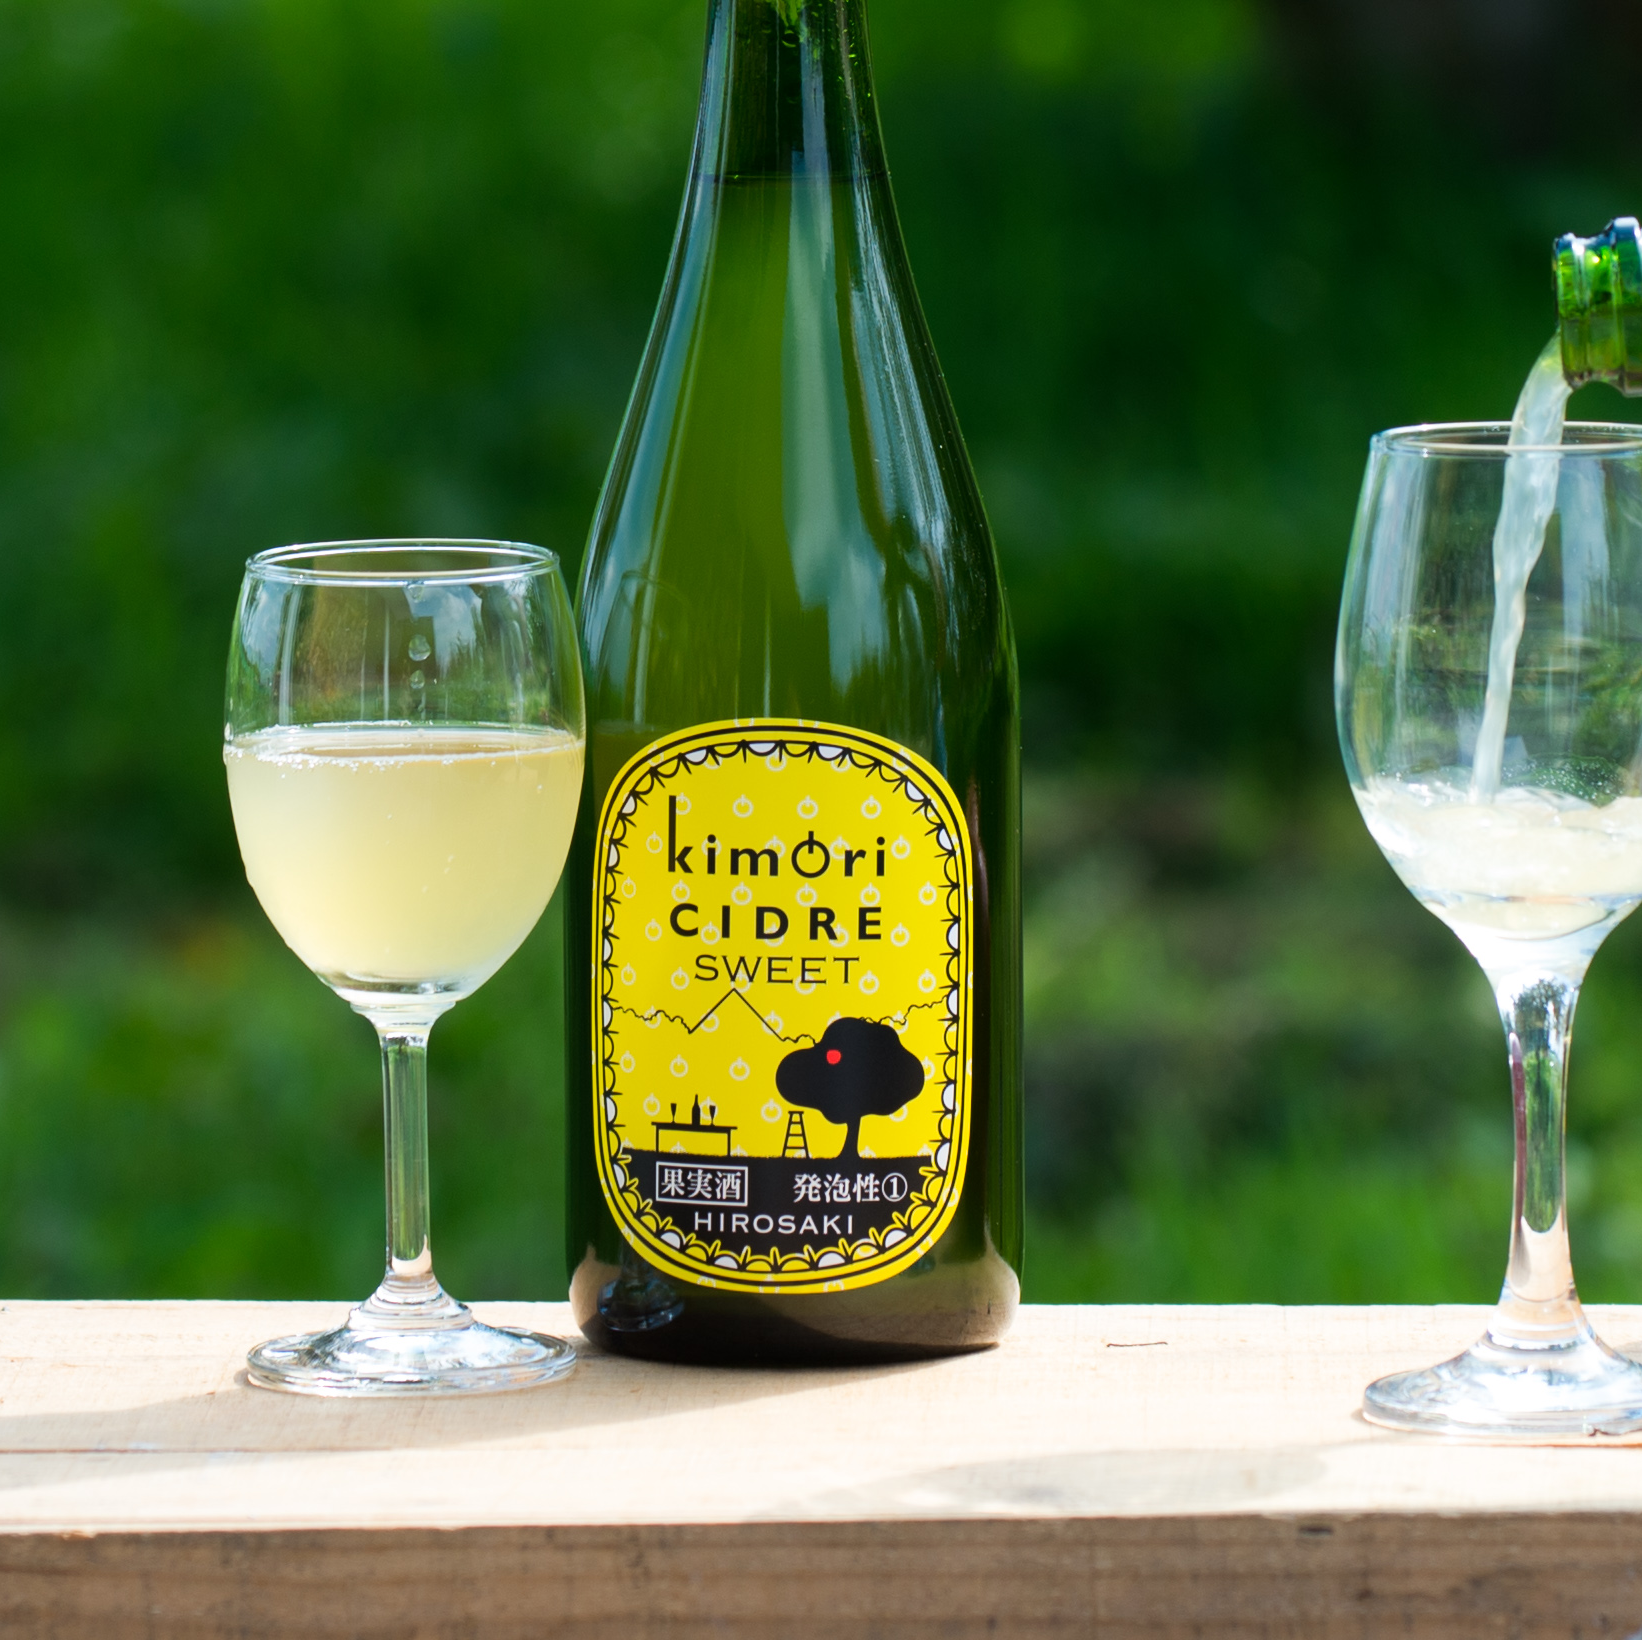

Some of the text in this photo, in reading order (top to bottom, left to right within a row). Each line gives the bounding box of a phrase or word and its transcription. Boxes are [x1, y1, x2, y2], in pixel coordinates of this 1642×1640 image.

[668, 795, 886, 878] kimori
[670, 903, 883, 940] CIDRE
[695, 954, 859, 984] SWEET
[660, 1168, 908, 1204] 果実酒 発泡性①
[695, 1211, 854, 1235] HIROSAKI
